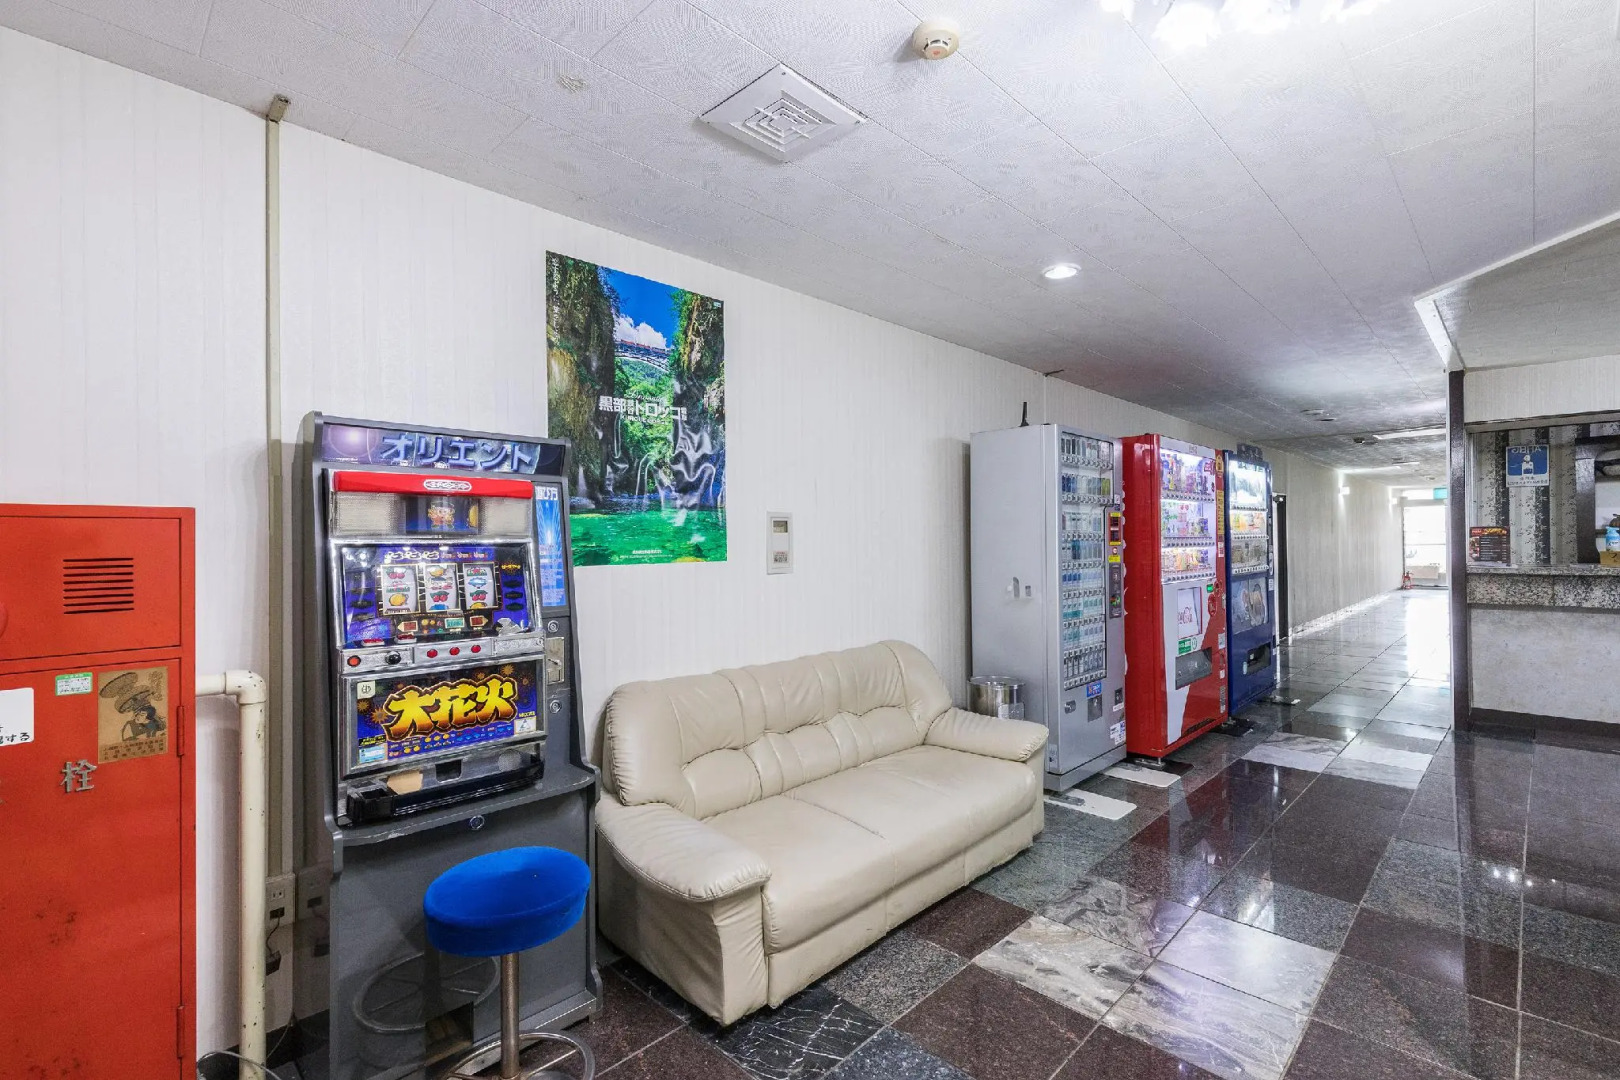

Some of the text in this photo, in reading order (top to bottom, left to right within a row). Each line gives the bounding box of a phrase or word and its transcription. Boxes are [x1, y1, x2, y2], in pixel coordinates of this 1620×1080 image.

[381, 432, 533, 471] オリエント
[384, 675, 517, 739] 大花火
[60, 758, 98, 794] 栓
